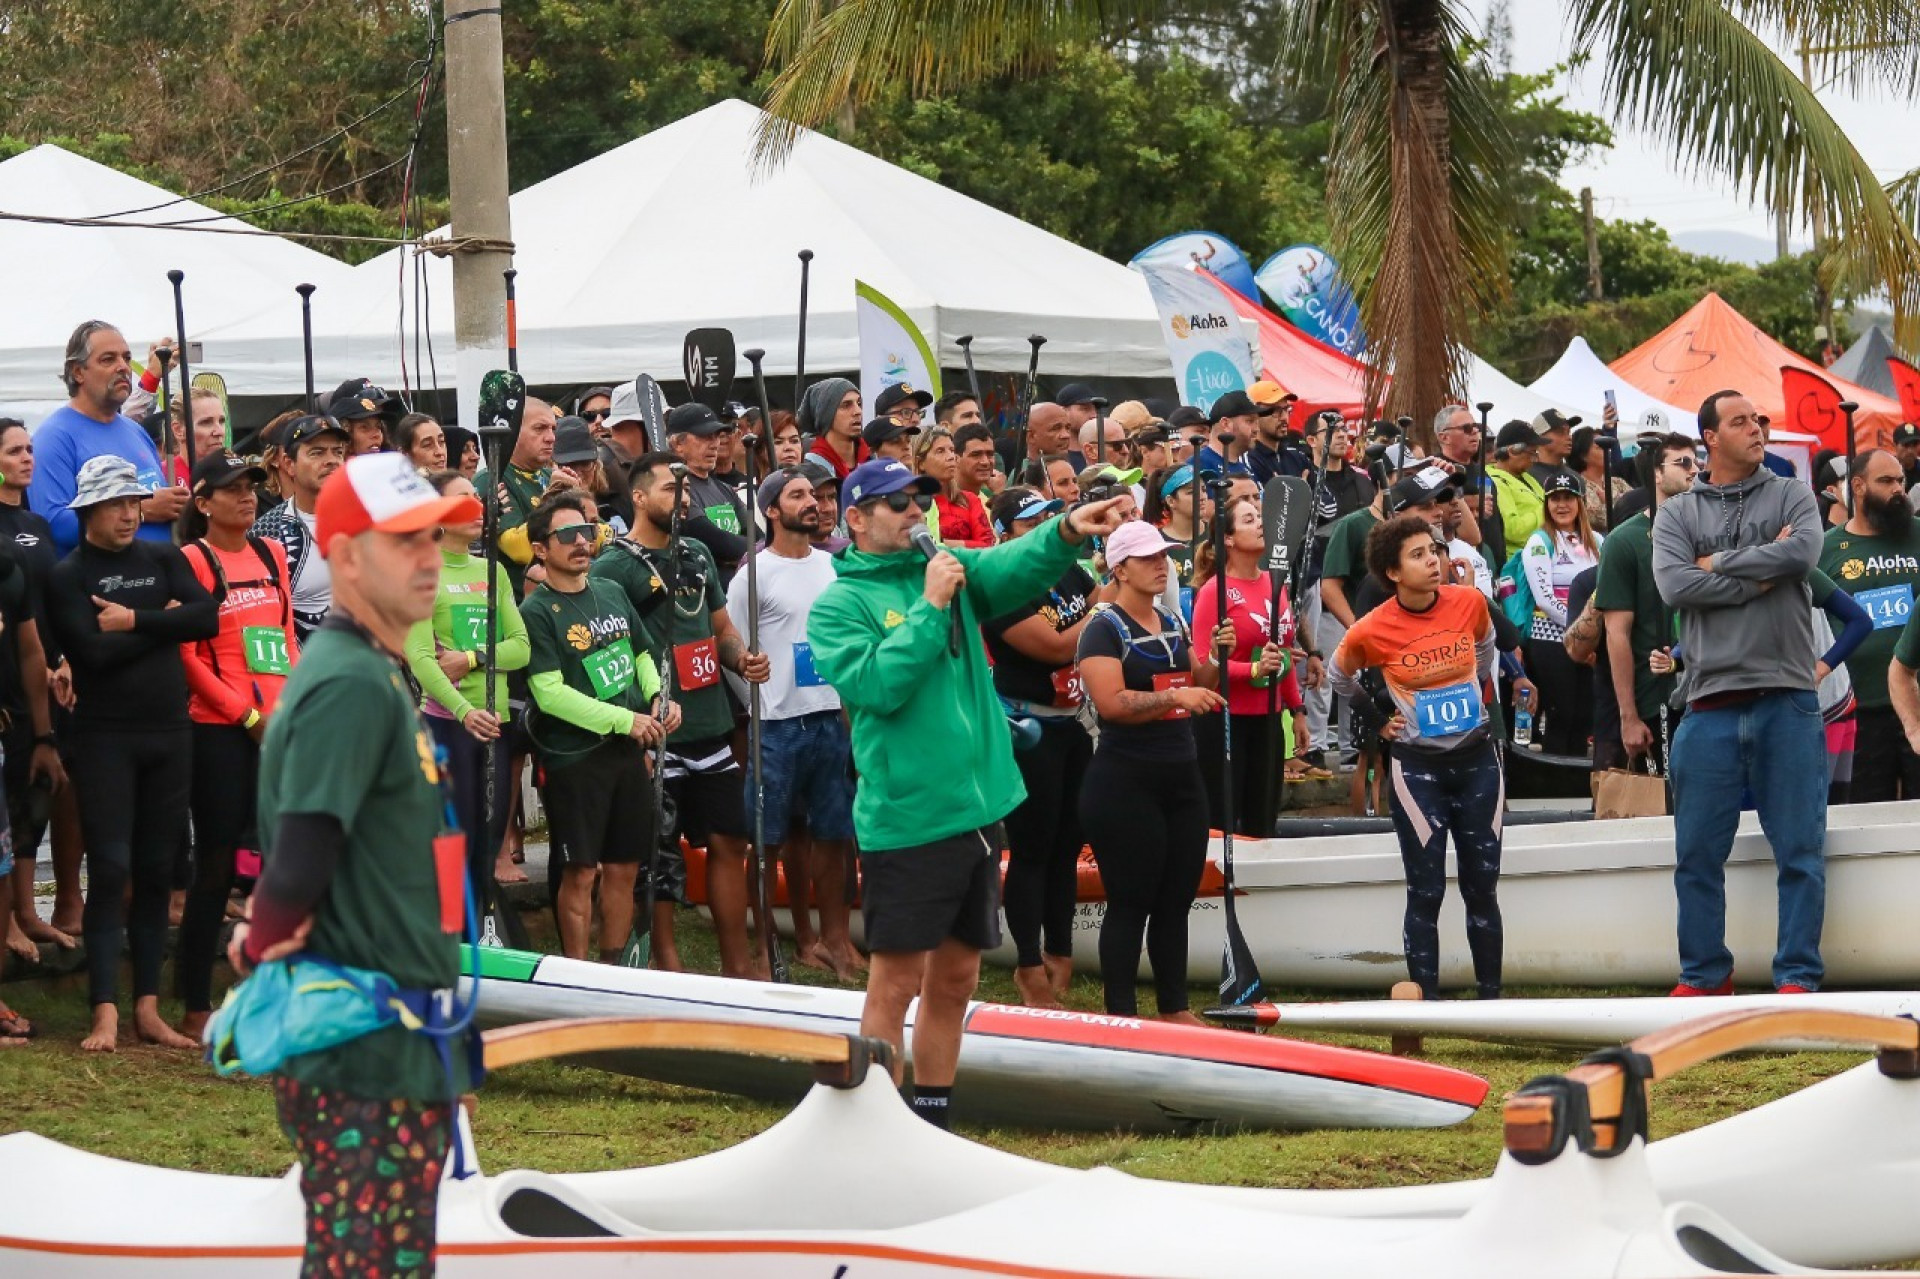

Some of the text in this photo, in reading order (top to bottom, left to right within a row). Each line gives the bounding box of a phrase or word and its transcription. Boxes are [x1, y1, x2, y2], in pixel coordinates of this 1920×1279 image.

[1190, 313, 1228, 330] Aloha
[1866, 555, 1918, 571] Aloha
[1866, 597, 1909, 620] 146
[1401, 637, 1471, 668] OSTRAS
[595, 654, 634, 688] 122
[692, 653, 716, 678] 36
[1424, 698, 1473, 725] 101
